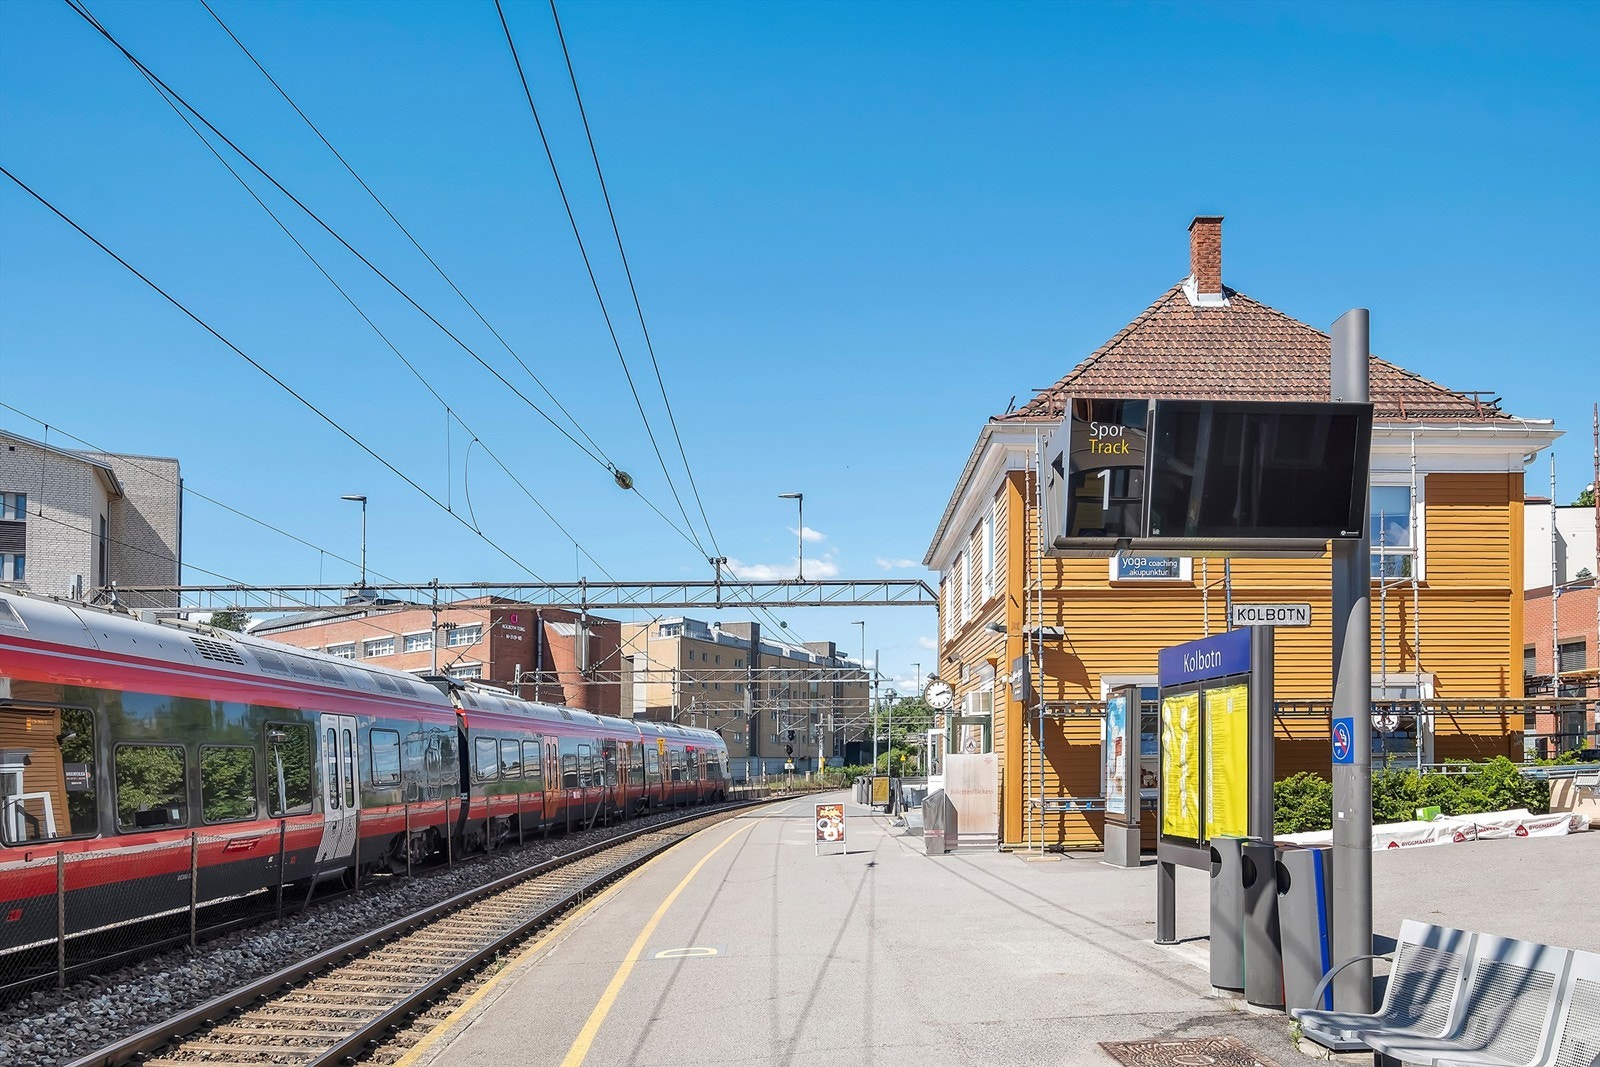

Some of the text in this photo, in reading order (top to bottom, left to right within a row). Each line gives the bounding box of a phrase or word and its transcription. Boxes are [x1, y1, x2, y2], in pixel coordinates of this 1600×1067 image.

[1089, 421, 1126, 440] Spor
[1088, 439, 1130, 454] Track
[1097, 469, 1111, 510] 1
[1122, 557, 1178, 568] yoga coaching
[1128, 568, 1170, 577] akupunktur
[1237, 608, 1306, 621] KOLBOTN
[1183, 650, 1222, 673] Kolbotn
[1401, 837, 1435, 847] BYGGMAKKER
